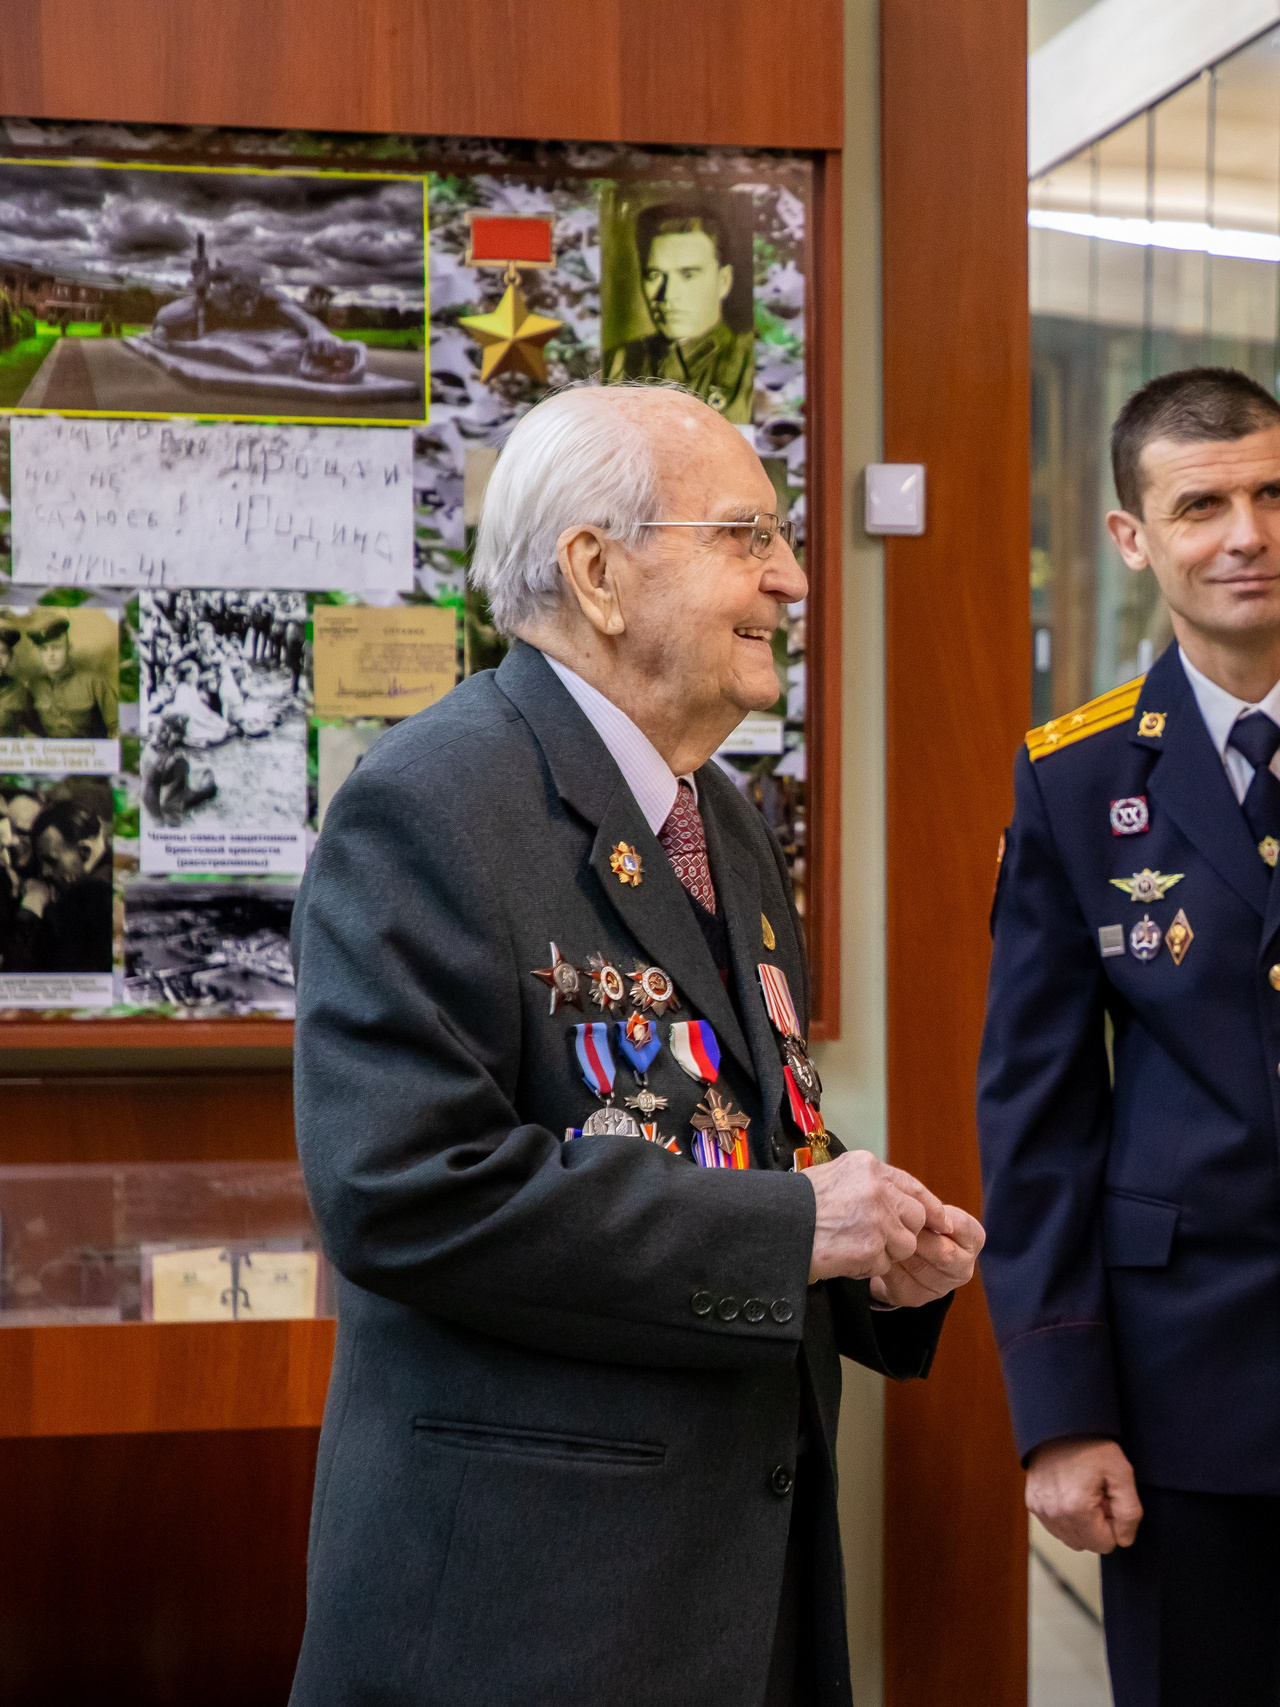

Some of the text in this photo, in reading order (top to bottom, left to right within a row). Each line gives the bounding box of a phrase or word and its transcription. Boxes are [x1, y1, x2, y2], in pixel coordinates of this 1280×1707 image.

[229, 834, 298, 845] защитников
[165, 844, 281, 857] Брестской крепости
